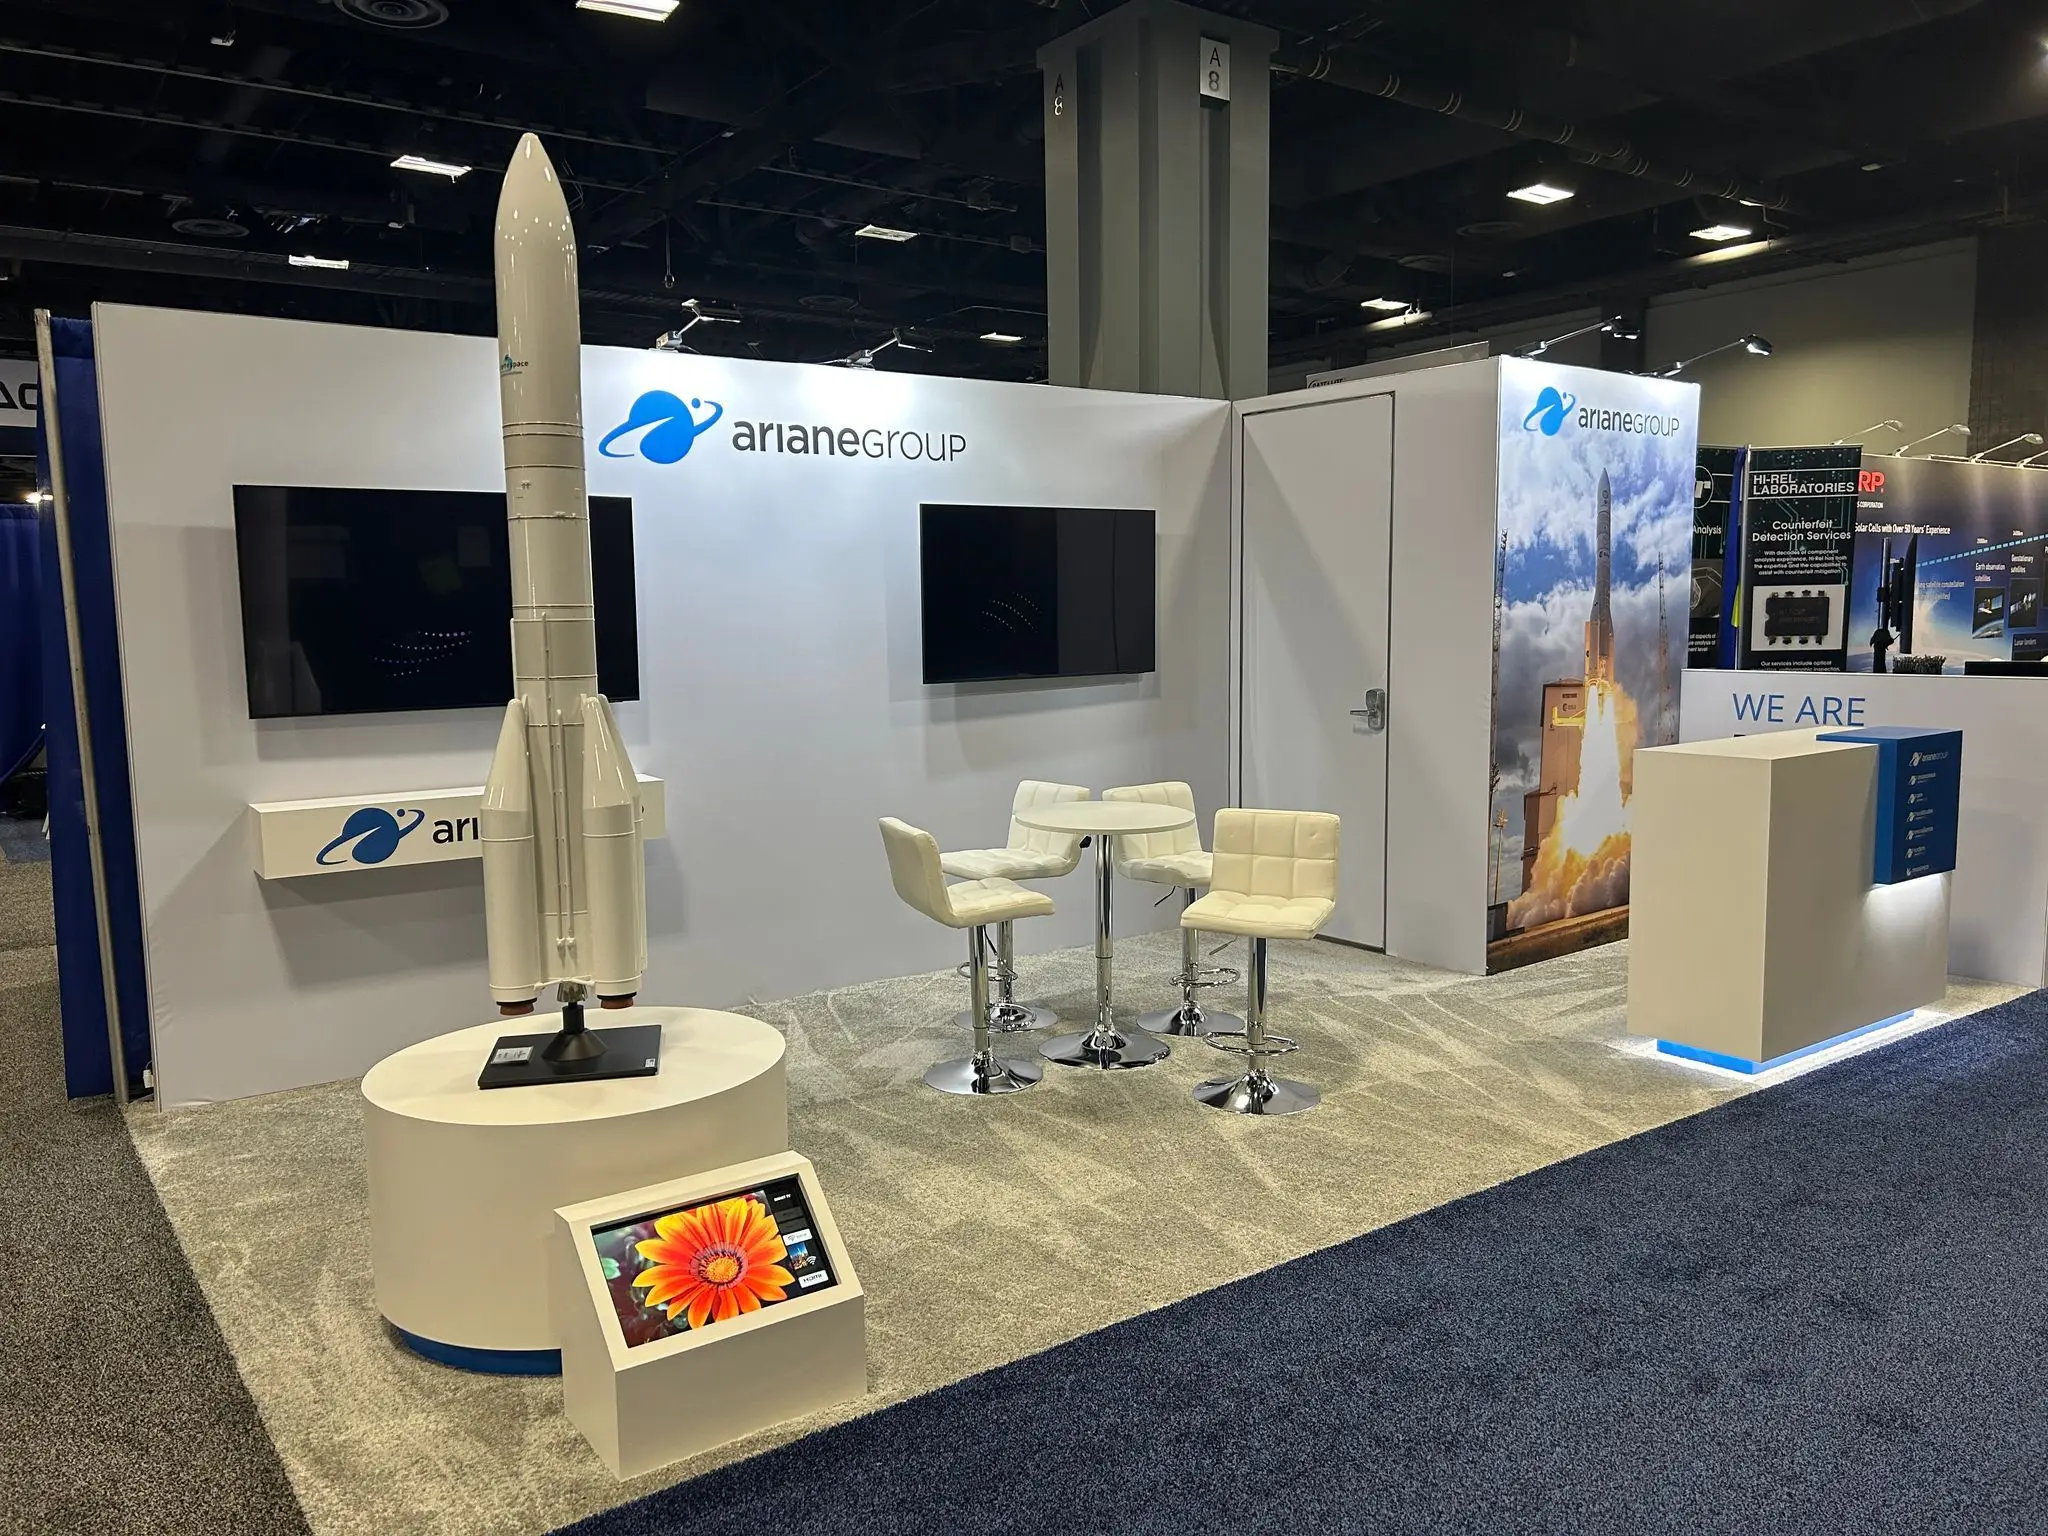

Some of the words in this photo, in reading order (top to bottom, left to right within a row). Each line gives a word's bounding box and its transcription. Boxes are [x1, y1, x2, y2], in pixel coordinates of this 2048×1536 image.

[1209, 47, 1221, 68] A
[1054, 74, 1064, 94] A
[1208, 70, 1220, 92] 8
[1754, 474, 1796, 484] HI-REL
[1753, 482, 1854, 495] LABORATORIES
[1772, 520, 1832, 530] Counterfeit
[1869, 523, 1881, 533] Cells
[1882, 524, 1892, 532] with
[1893, 524, 1904, 533] Over
[1926, 525, 1951, 536] Experience
[1752, 532, 1804, 542] Detection
[1806, 531, 1851, 540] Services
[1732, 694, 1784, 723] WE
[1795, 696, 1866, 727] ARE
